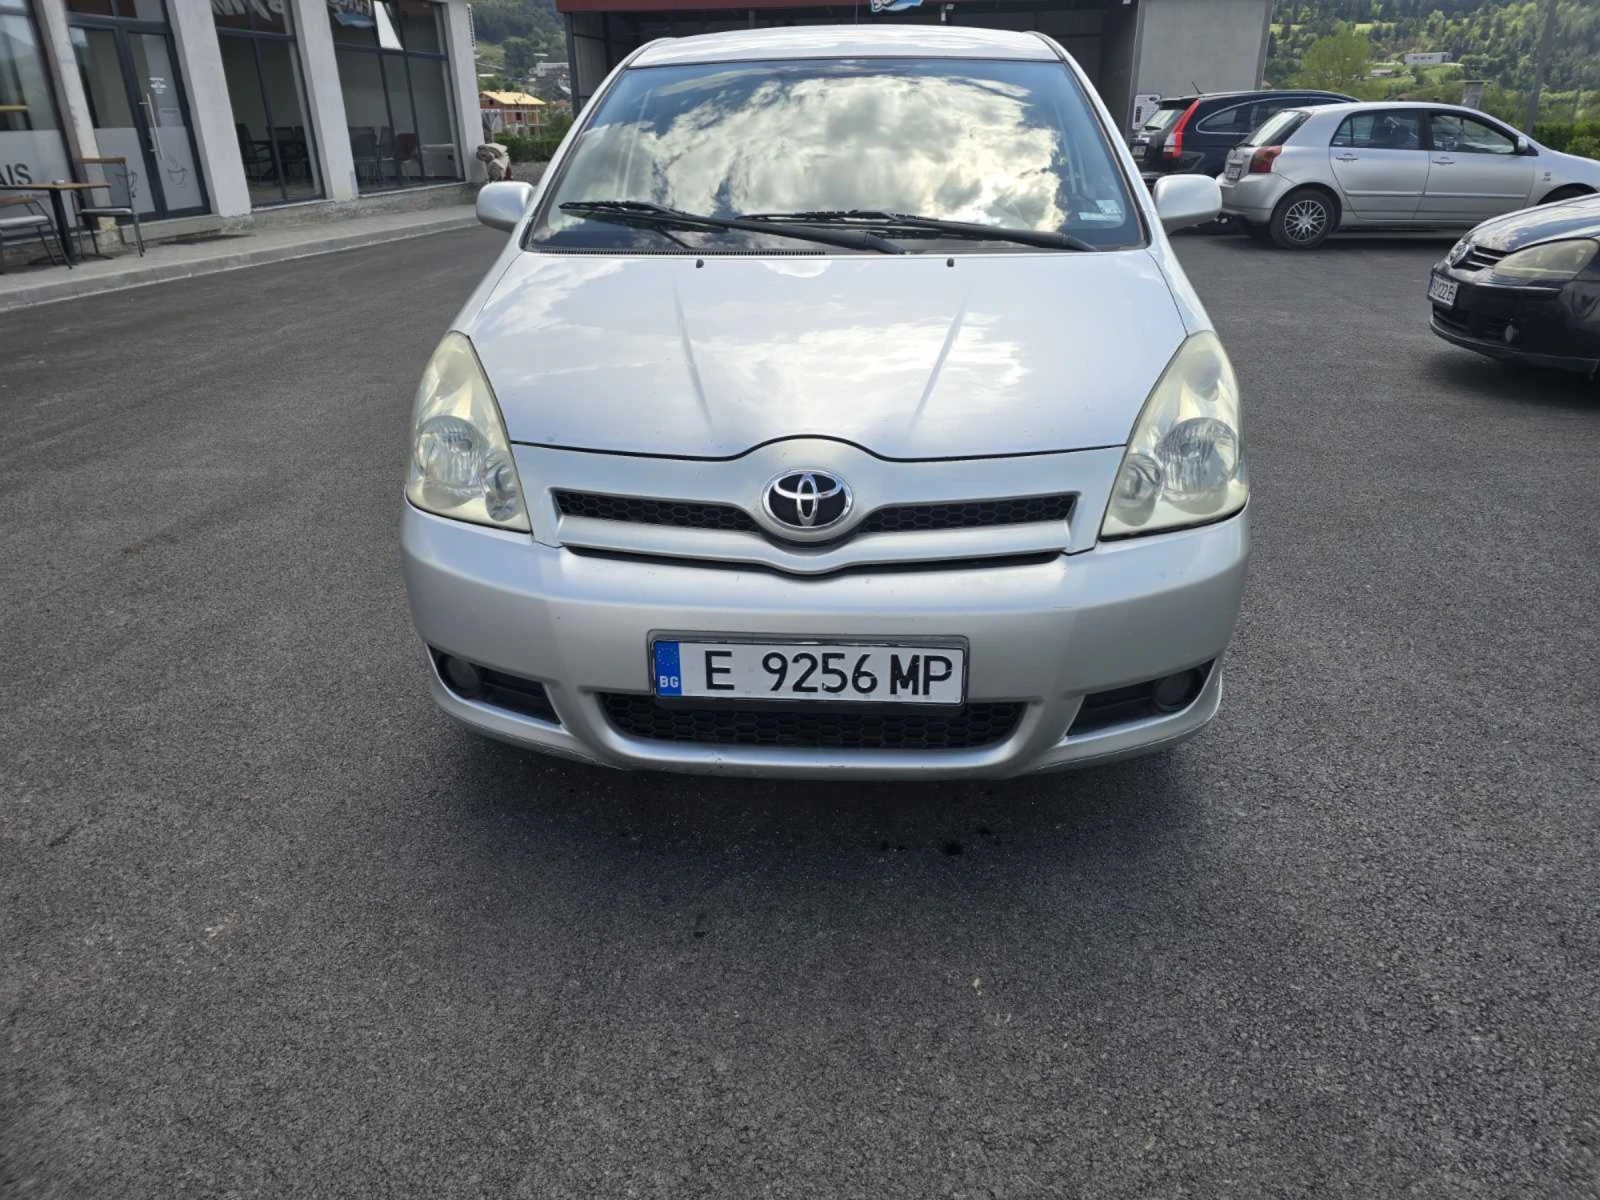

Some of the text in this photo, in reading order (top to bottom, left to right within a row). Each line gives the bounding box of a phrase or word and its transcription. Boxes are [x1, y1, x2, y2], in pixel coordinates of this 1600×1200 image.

[659, 676, 679, 688] BG
[705, 650, 953, 696] E 9256 MP
